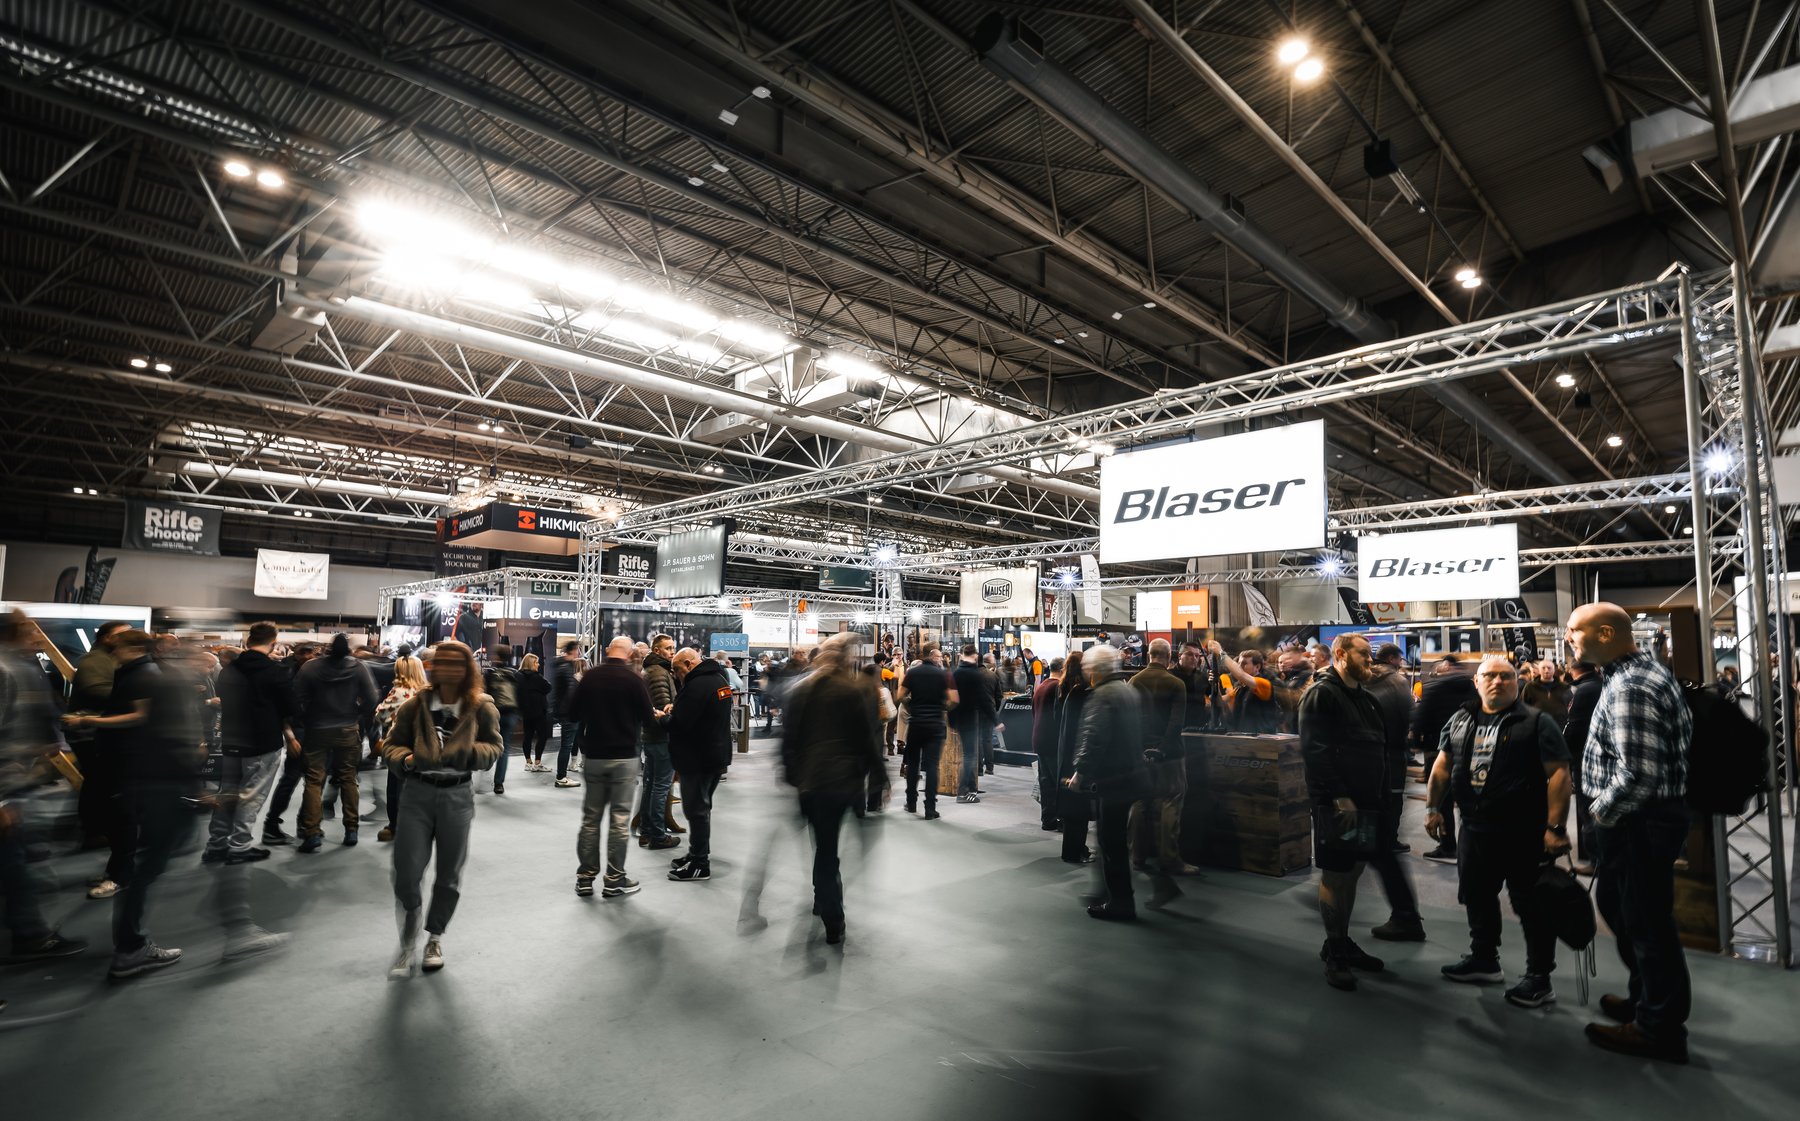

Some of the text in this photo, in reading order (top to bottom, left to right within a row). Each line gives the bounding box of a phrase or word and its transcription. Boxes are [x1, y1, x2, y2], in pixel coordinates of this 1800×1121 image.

[1114, 478, 1306, 524] Blaser
[145, 506, 204, 531] Rifle
[459, 514, 484, 532] HIKMICRO
[540, 516, 602, 535] HIKMIC
[144, 526, 203, 543] Shooter
[443, 552, 464, 560] SECURE
[619, 554, 649, 571] Rifle
[672, 556, 691, 565] SAUER
[698, 553, 715, 562] SOHN
[618, 568, 649, 579] Shooter
[1369, 557, 1506, 578] Blaser
[533, 582, 559, 593] EXIT
[984, 583, 1010, 598] MAUSER
